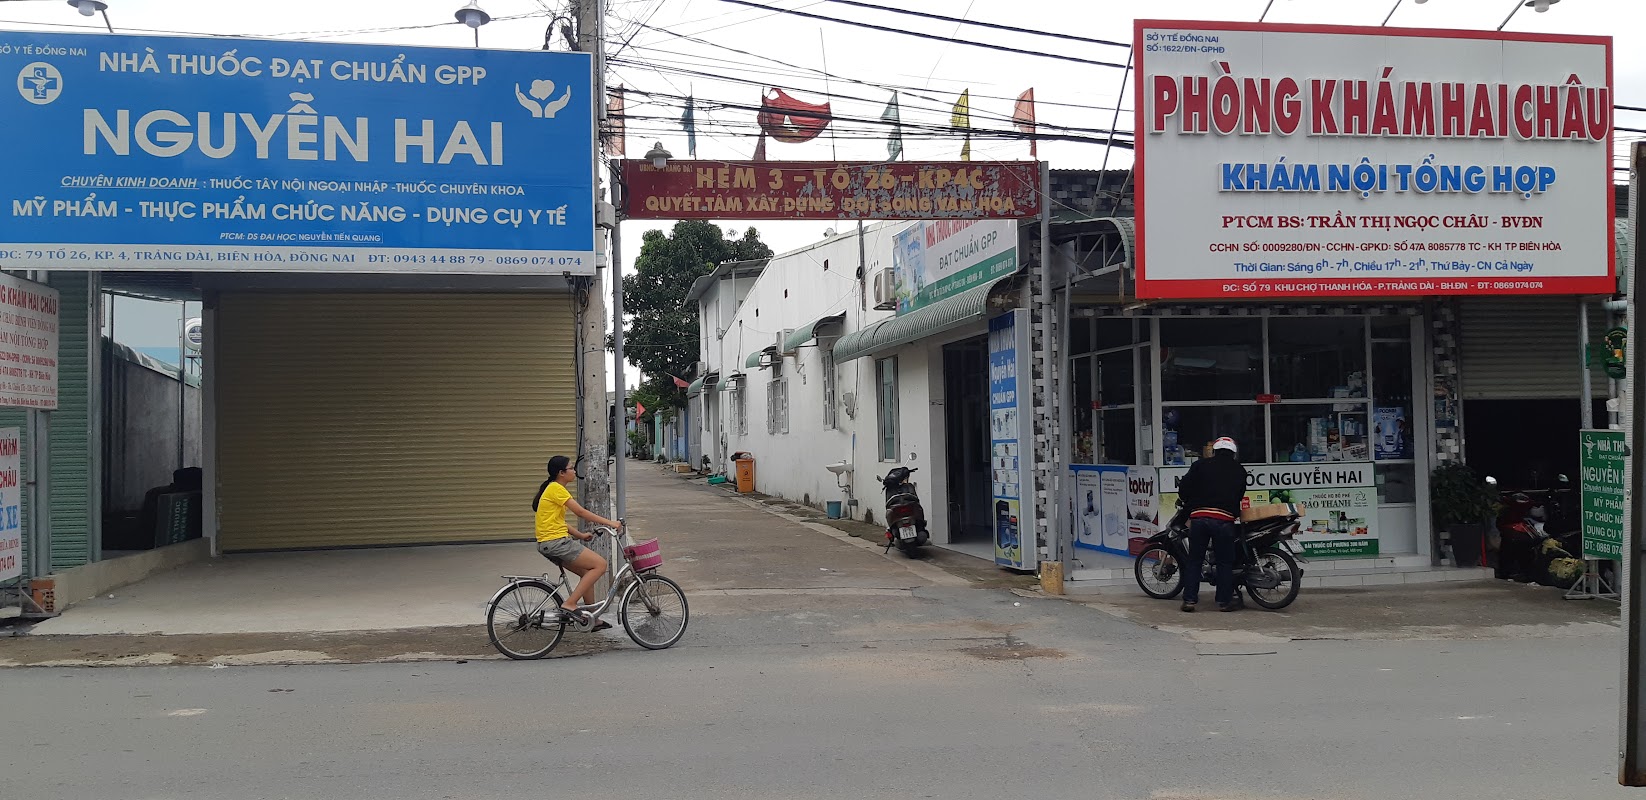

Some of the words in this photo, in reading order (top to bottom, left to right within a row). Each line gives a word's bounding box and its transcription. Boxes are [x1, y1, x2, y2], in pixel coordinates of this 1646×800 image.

[1146, 32, 1159, 41] SỞ
[1167, 33, 1179, 42] TẾ
[1204, 35, 1219, 43] NAI
[14, 46, 21, 54] Y
[23, 44, 34, 55] TẾ
[35, 44, 67, 56] ĐỒNG
[69, 48, 87, 56] NAI
[100, 46, 160, 73] NHÀ
[168, 48, 262, 77] THUỐC
[270, 58, 323, 83] ĐẠT
[330, 54, 426, 83] CHUẨN
[434, 64, 487, 86] GPP
[1151, 60, 1303, 136] PHÒNG
[1309, 66, 1436, 137] KHÁM
[1440, 82, 1510, 138] HAI
[1513, 73, 1610, 141] CHÂU
[83, 91, 369, 162] NGUYỄN
[394, 118, 503, 166] HAI
[60, 174, 112, 188] CHUYÊN
[116, 176, 147, 188] KINH
[149, 177, 197, 189] DOANH
[209, 176, 253, 190] THUỐC
[256, 176, 279, 190] TÂY
[281, 178, 305, 192] NỘI
[308, 180, 351, 194] NGOẠI
[354, 180, 388, 195] NHẬP
[440, 182, 487, 195] CHUYÊN
[491, 185, 525, 196] KHOA
[768, 168, 784, 190] 3
[865, 168, 896, 190] 26
[918, 168, 986, 190] KP4C
[1221, 156, 1322, 192] KHÁM
[1327, 156, 1388, 199] NỘI
[1394, 153, 1487, 193] TỔNG
[1492, 165, 1556, 199] HỢP
[12, 195, 47, 217] MỸ
[53, 192, 117, 218] PHẨM
[139, 200, 196, 222] THỰC
[203, 195, 266, 220] PHẨM
[272, 199, 335, 221] CHỨC
[341, 201, 406, 223] NĂNG
[427, 206, 488, 227] DỤNG
[493, 207, 522, 228] CỤ
[529, 209, 542, 224] Y
[547, 204, 568, 226] TẾ
[646, 192, 701, 212] QUYẾT
[705, 193, 743, 212] TÂM
[746, 193, 781, 212] XÂY
[1221, 215, 1274, 229] PTCM
[1277, 215, 1305, 229] BS:
[1307, 210, 1357, 229] TRẦN
[1359, 215, 1391, 232] THỊ
[1394, 215, 1440, 232] NGỌC
[1442, 213, 1489, 229] CHÂU
[1501, 216, 1544, 229] BVĐN
[220, 232, 246, 241] PTCM:
[247, 232, 258, 241] DS
[259, 232, 275, 242] ĐẠI
[277, 233, 297, 242] HỌC
[334, 231, 351, 242] TIẾN
[352, 233, 381, 243] QUANG
[1209, 243, 1239, 252] CCHN
[1243, 240, 1260, 252] SỐ:
[1394, 239, 1408, 251] SỐ
[1409, 242, 1426, 251] 47A
[1427, 242, 1466, 251] 8085778
[1468, 242, 1481, 251] TC
[1488, 243, 1502, 251] KH
[1505, 243, 1517, 251] TP
[1519, 241, 1541, 251] BIÊN
[1542, 241, 1562, 251] HÒA
[26, 250, 43, 260] 79
[70, 250, 91, 261] 26,
[94, 251, 115, 260] KP.
[118, 251, 130, 261] 4,
[217, 250, 250, 262] BIÊN
[254, 250, 286, 263] HÒA,
[289, 250, 328, 263] ĐỒNG
[332, 253, 355, 263] NAI
[368, 254, 390, 264] ĐT:
[393, 254, 426, 264] 0943
[430, 255, 446, 264] 44
[449, 255, 466, 264] 88
[469, 255, 485, 264] 79
[496, 256, 528, 265] 0869
[531, 256, 555, 265] 074
[558, 257, 582, 266] 074
[939, 252, 953, 271] ĐẠT
[954, 234, 979, 263] CHUẨN
[981, 230, 998, 251] GPP
[1234, 261, 1257, 272] Thời
[1259, 261, 1286, 272] Gian:
[1287, 261, 1314, 274] Sáng
[1354, 260, 1383, 271] Chiều
[1431, 260, 1450, 270] Thứ
[1452, 259, 1470, 272] Bảy
[1477, 261, 1492, 270] CN
[1495, 259, 1508, 270] Cả
[1510, 260, 1534, 272] Ngày
[1223, 284, 1240, 292] ĐC:
[1242, 281, 1257, 292] SỐ
[1260, 284, 1271, 292] 79
[1275, 284, 1295, 292] KHU
[1296, 283, 1317, 293] CHỢ
[1352, 280, 1373, 291] HÓA
[1419, 280, 1434, 290] DÀI
[1494, 281, 1515, 289] 0869
[1515, 281, 1529, 289] 074
[1529, 281, 1543, 289] 074
[1597, 436, 1611, 452] NHÀ
[1269, 466, 1332, 486] NGUYỄN
[1336, 470, 1362, 484] HAI
[1320, 499, 1352, 508] THANH
